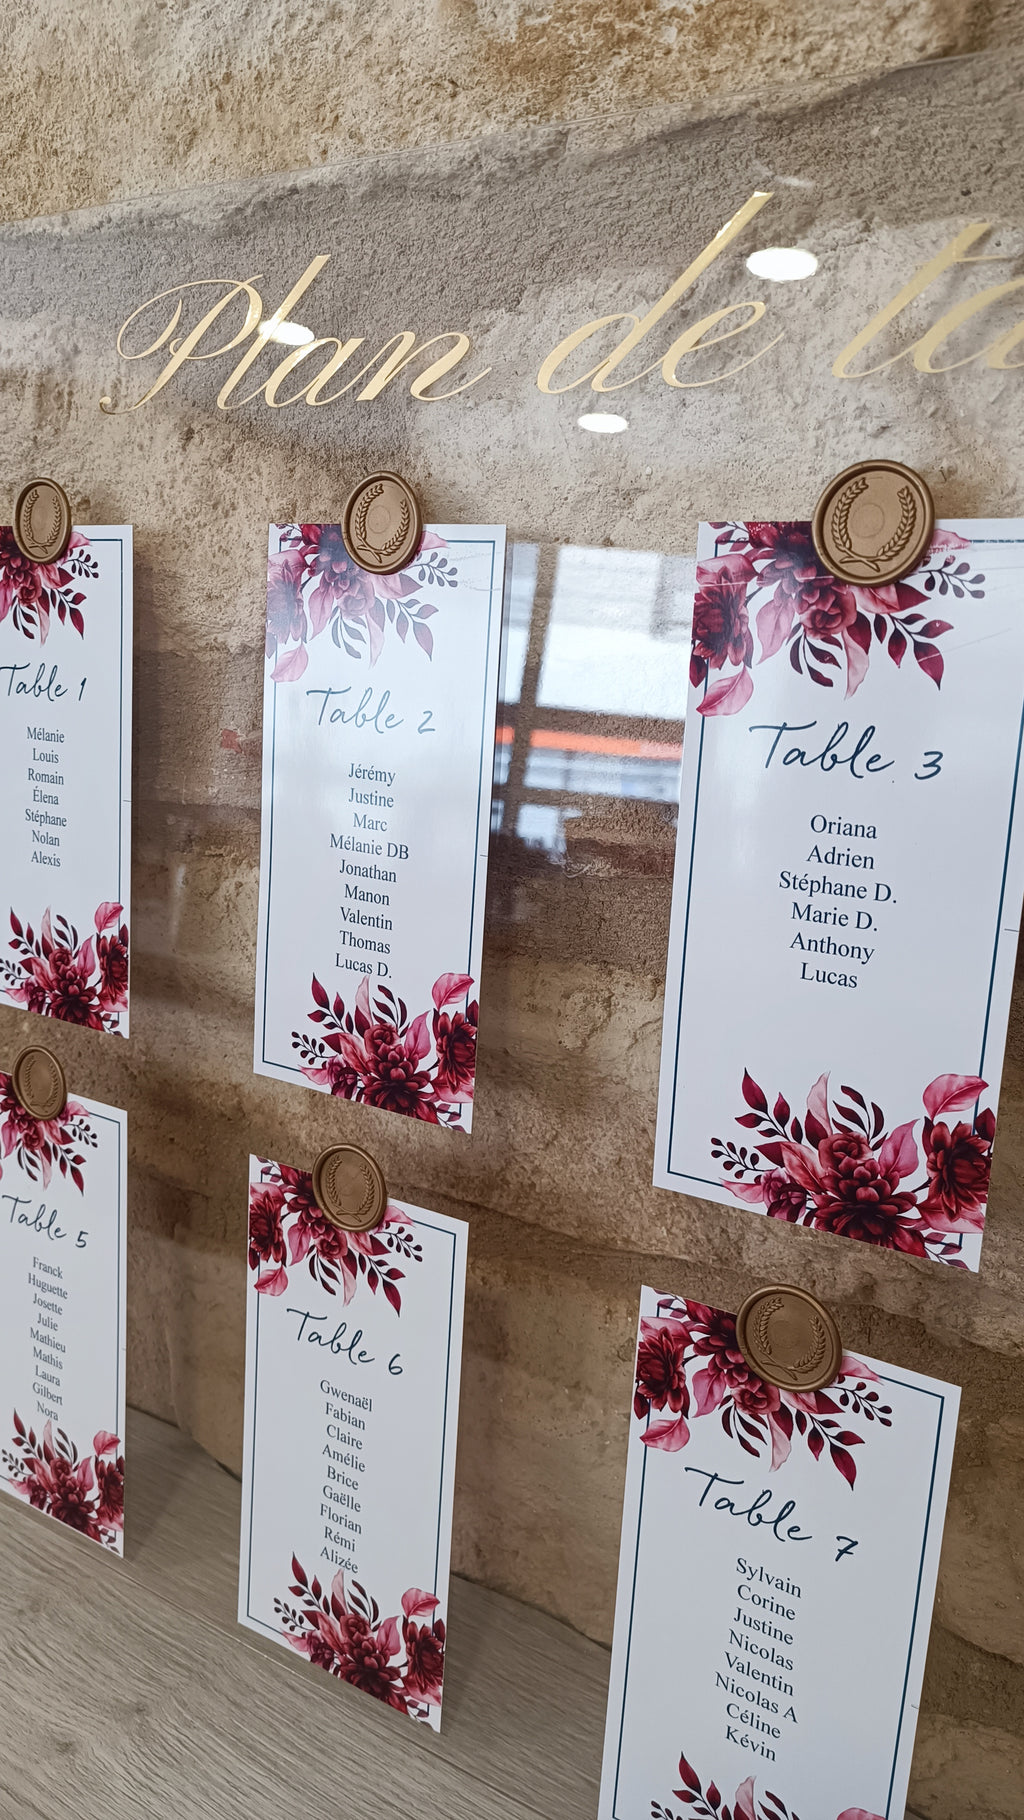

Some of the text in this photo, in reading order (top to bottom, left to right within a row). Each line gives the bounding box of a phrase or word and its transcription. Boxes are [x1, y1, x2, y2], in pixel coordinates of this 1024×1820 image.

[99, 254, 493, 415] Plan
[536, 190, 786, 394] de
[0, 662, 88, 702] Table 1
[305, 685, 437, 735] Table 2
[26, 725, 65, 744] Mélanie
[32, 747, 60, 764] Louis
[748, 720, 944, 781] Table 3
[27, 767, 65, 786] Romain
[347, 762, 397, 788] Jérémy
[32, 785, 60, 806] Élena
[347, 787, 395, 809] Justine
[24, 808, 68, 828] Stéphane
[352, 812, 388, 833] Marc
[809, 814, 878, 840] Oriana
[31, 829, 61, 848] Nolan
[329, 832, 409, 861] Mélanie DB
[30, 851, 62, 868] Alexis
[339, 858, 398, 883] Jonathan
[805, 844, 876, 870] Adrien
[343, 883, 391, 907] Manon
[778, 870, 898, 904] Stéphane D.
[339, 906, 394, 931] Valentin
[790, 901, 879, 932] Marie D.
[339, 929, 391, 955] Thomas
[789, 931, 876, 965] Anthony
[334, 952, 393, 979] Lucas D.
[799, 961, 859, 989] Lucas
[1, 1194, 90, 1249] Table 5
[32, 1255, 64, 1280] Franck
[27, 1272, 69, 1300] Huguette
[32, 1292, 63, 1316] Josette
[36, 1312, 59, 1332] Julie
[29, 1326, 67, 1354] Mathieu
[285, 1307, 404, 1376] Table 6
[32, 1345, 64, 1371] Mathis
[34, 1364, 61, 1387] Laura
[32, 1381, 63, 1406] Gilbert
[319, 1378, 373, 1413] Gwenaël
[36, 1400, 59, 1422] Nora
[325, 1401, 367, 1431] Fabian
[325, 1423, 364, 1451] Claire
[321, 1443, 367, 1473] Amélie
[326, 1464, 360, 1491] Brice
[322, 1484, 362, 1514] Gaëlle
[319, 1502, 363, 1535] Florian
[683, 1466, 859, 1563] Table 7
[323, 1525, 356, 1553] Rémi
[319, 1545, 359, 1575] Alizée
[735, 1557, 802, 1600] Sylvain
[736, 1583, 797, 1622] Corine
[733, 1606, 795, 1646] Justine
[728, 1627, 795, 1672] Nicolas
[724, 1650, 795, 1697] Valentin
[714, 1670, 799, 1724] Nicolas A
[725, 1702, 782, 1740] Céline
[725, 1724, 777, 1763] Kévin
